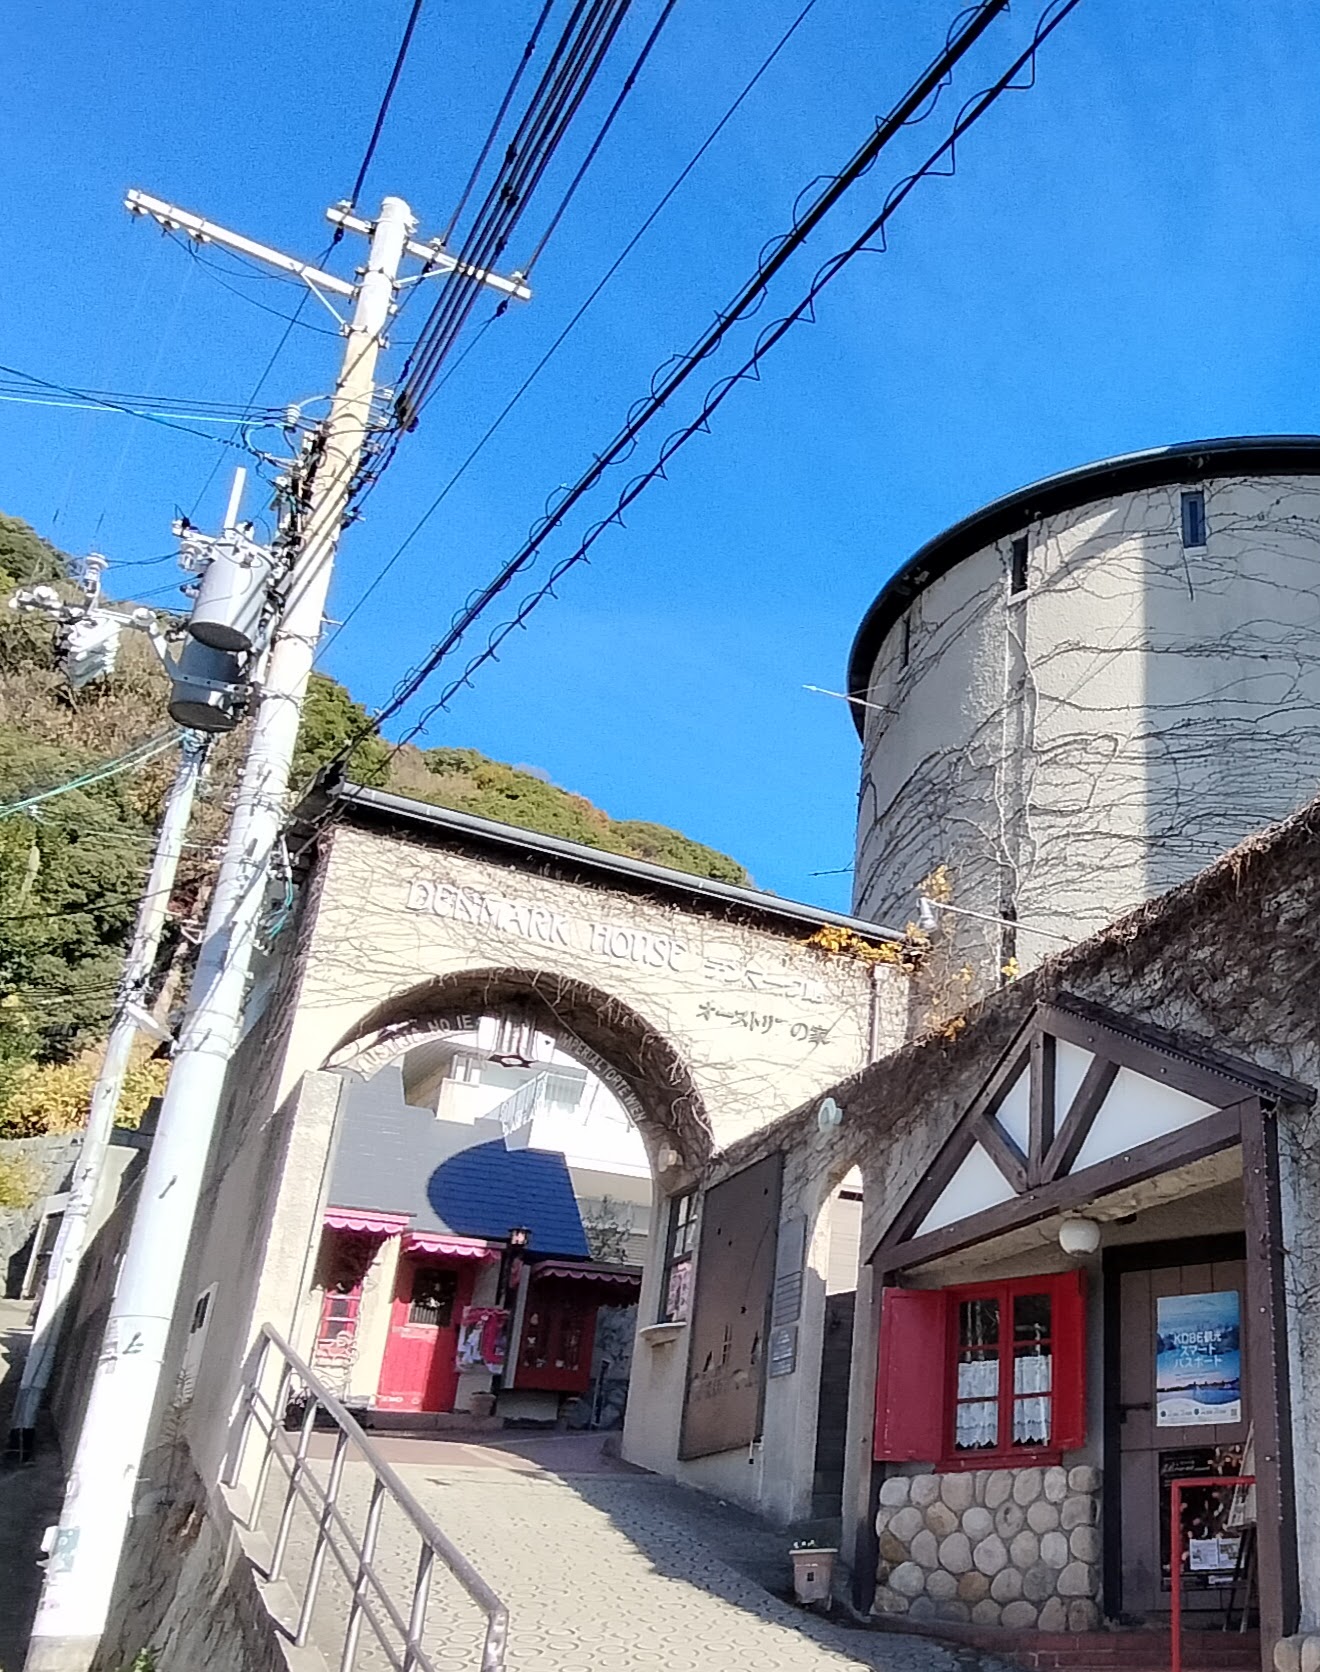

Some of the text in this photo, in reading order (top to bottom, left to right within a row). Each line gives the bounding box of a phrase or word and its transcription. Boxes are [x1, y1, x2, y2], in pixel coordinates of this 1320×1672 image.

[405, 878, 688, 972] DENMARK HOUSE
[456, 1014, 474, 1030] IE
[559, 1031, 647, 1122] IMPERIAL TORTE WIEN
[1180, 1343, 1217, 1357] スマート
